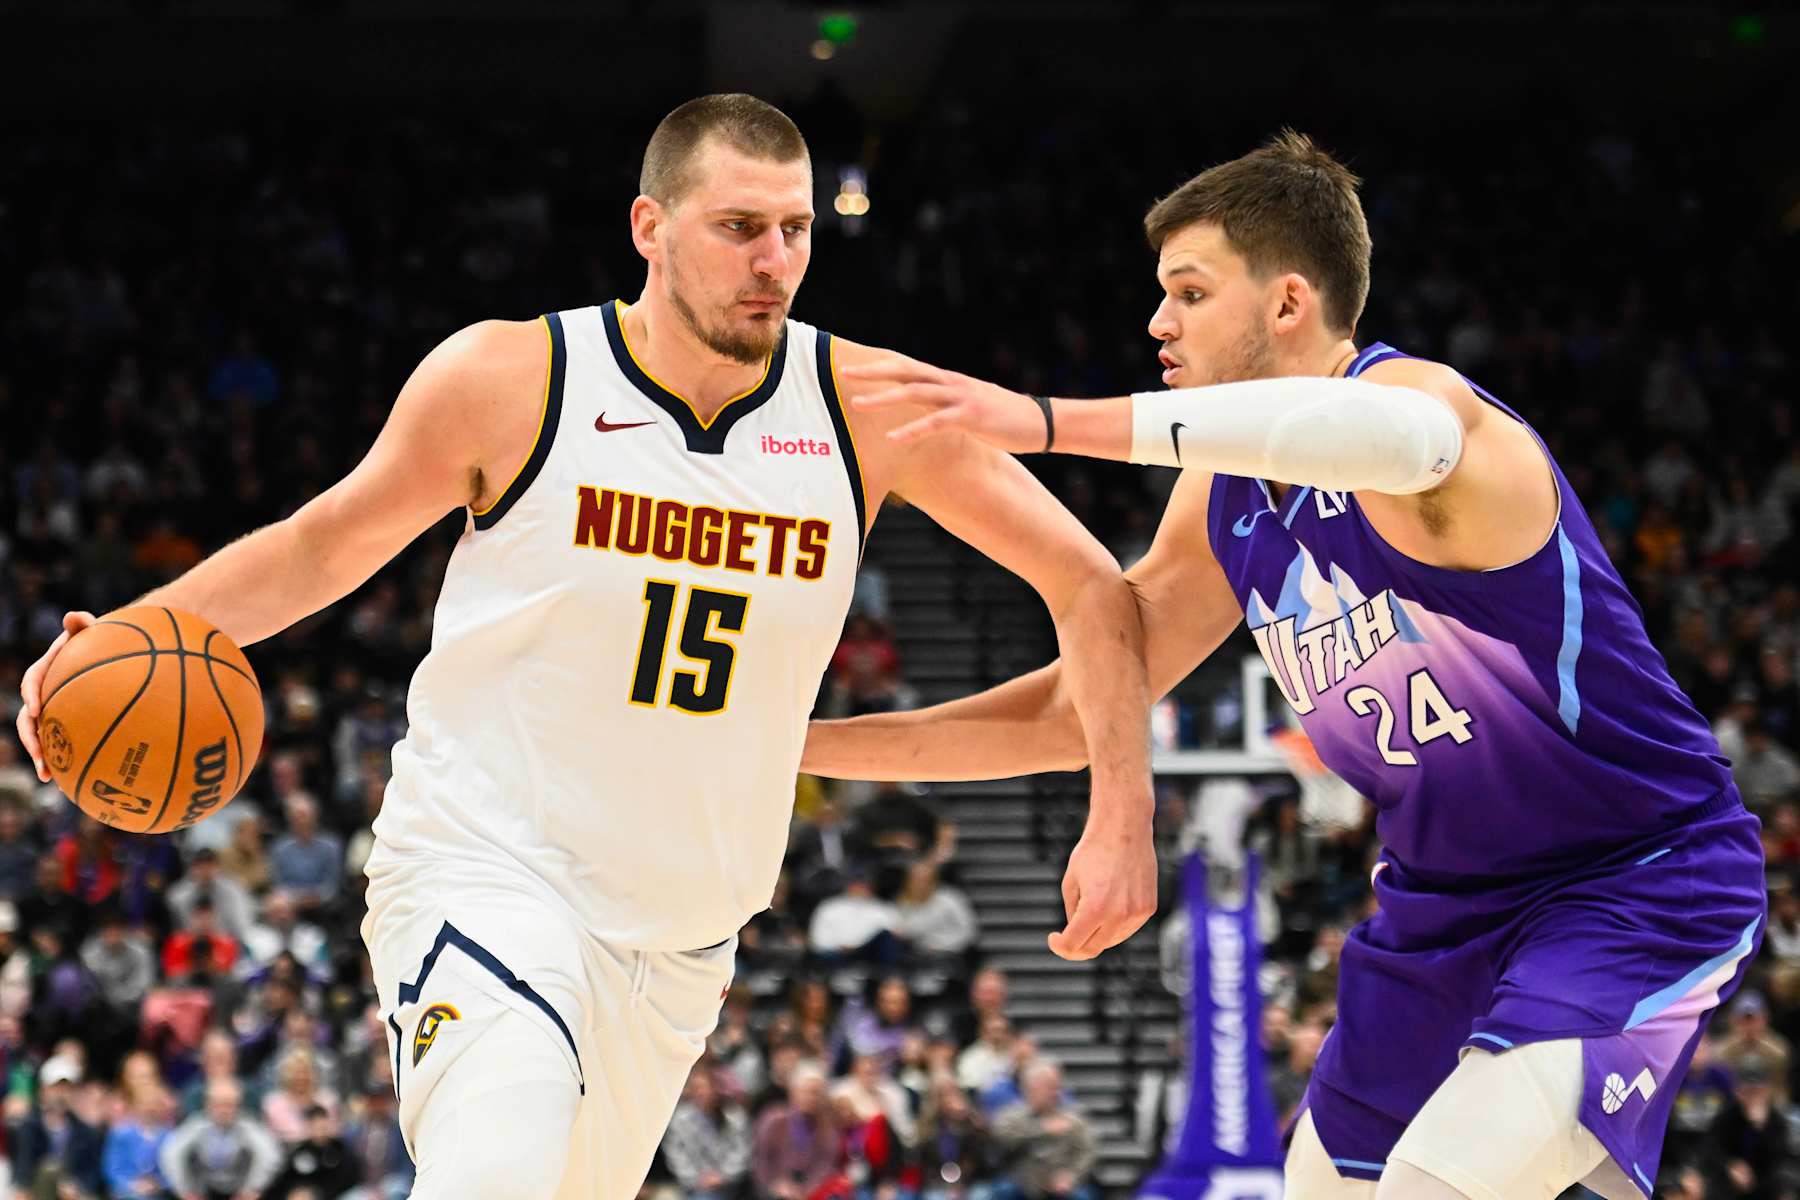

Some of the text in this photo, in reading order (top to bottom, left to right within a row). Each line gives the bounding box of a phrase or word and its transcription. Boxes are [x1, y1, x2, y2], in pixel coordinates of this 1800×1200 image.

[761, 435, 831, 456] ibotta
[573, 484, 832, 581] NUGGETS
[628, 577, 752, 716] 15
[1345, 667, 1473, 766] 24
